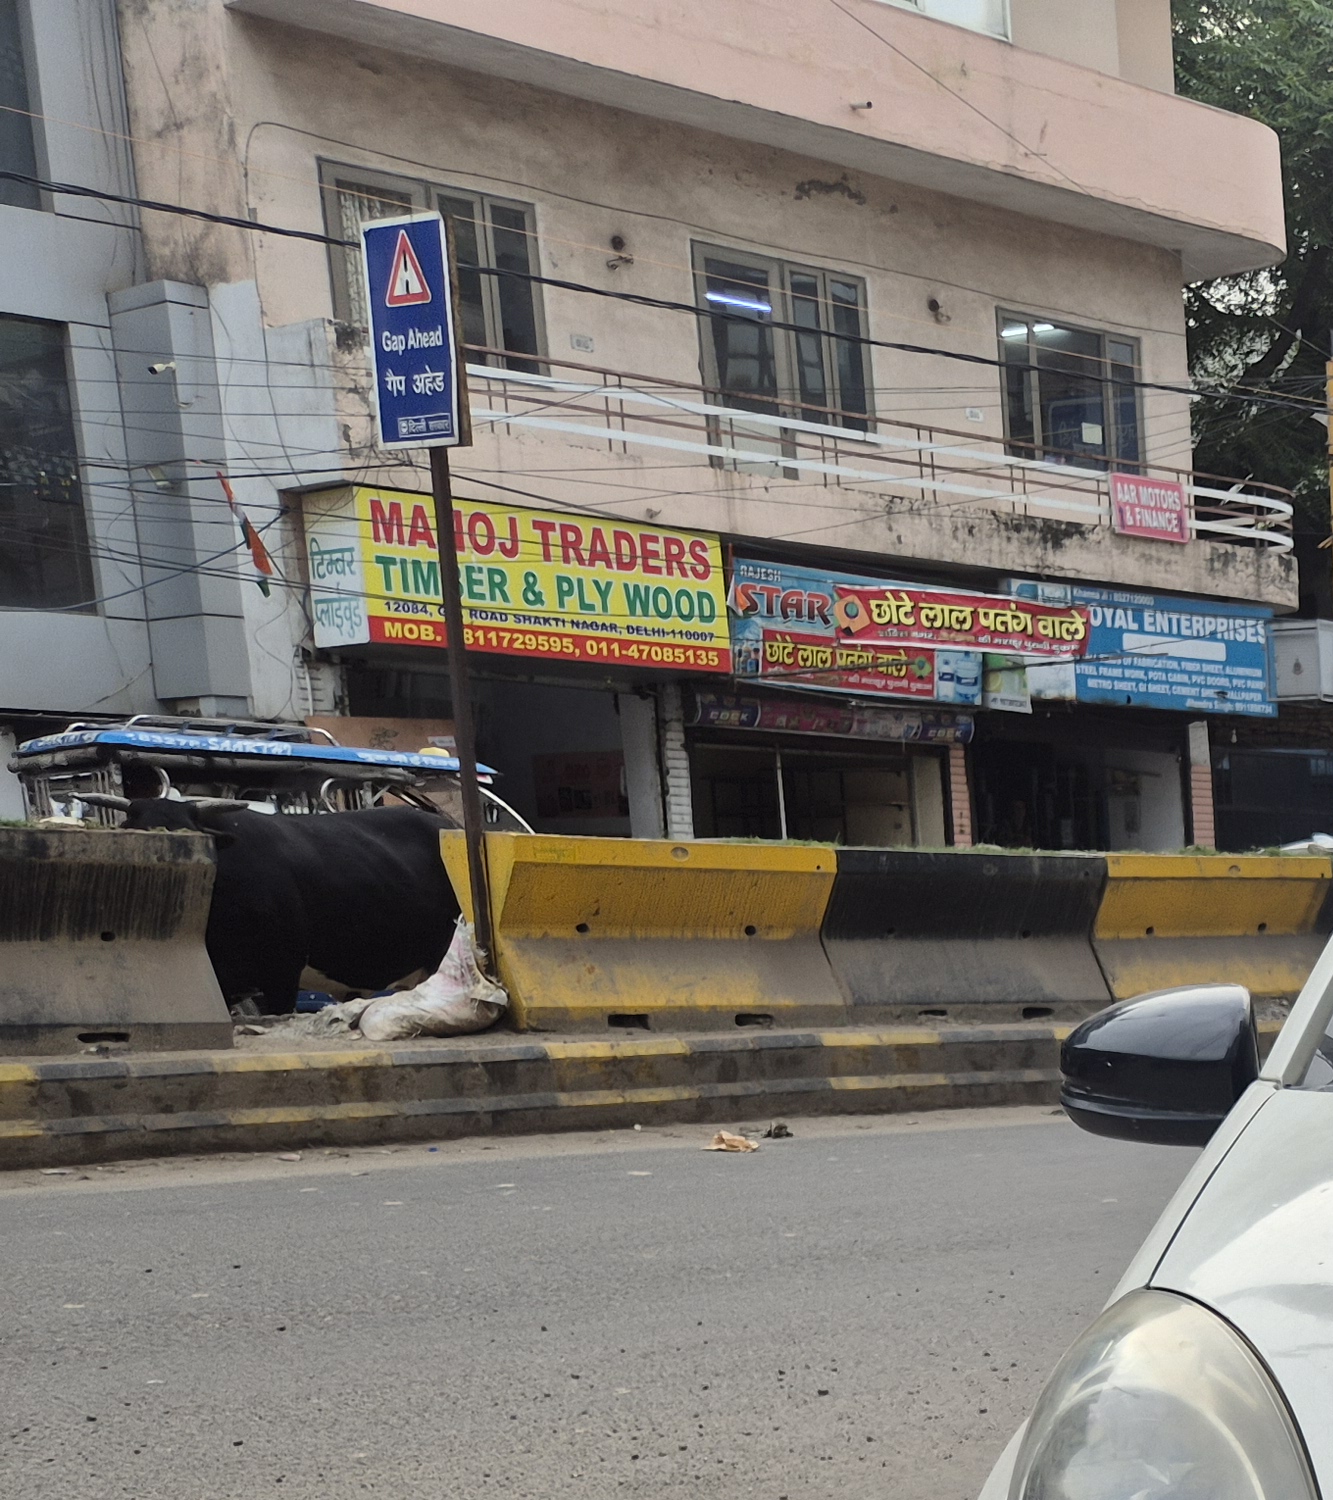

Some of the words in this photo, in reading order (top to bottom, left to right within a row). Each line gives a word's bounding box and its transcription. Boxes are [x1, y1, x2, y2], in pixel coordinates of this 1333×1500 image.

[382, 331, 406, 355] Gap
[408, 325, 443, 350] Ahead
[384, 368, 407, 397] गैप
[412, 365, 445, 396] अहेड
[1138, 485, 1181, 511] MOTORS
[1134, 507, 1180, 533] FINANCE
[532, 519, 712, 581] TRADERS
[375, 554, 510, 604] TIMER
[522, 571, 545, 607] &
[556, 574, 614, 614] PLY
[623, 582, 716, 624] WOOD
[739, 565, 782, 582] RAJESH
[469, 610, 509, 624] ROAD
[513, 614, 566, 629] SHAKTI
[571, 619, 622, 635] NAGAR,
[738, 583, 833, 629] STAR
[869, 591, 916, 626] छोटे
[919, 602, 975, 631] लाल
[977, 602, 1034, 636] पतंग
[1036, 610, 1088, 641] वाले
[1090, 604, 1139, 631] OYAL
[1144, 610, 1266, 644] ENTERPRISES
[384, 621, 443, 642] MOB.
[463, 628, 581, 657] 811729595,
[585, 640, 719, 667] 011-47085135
[764, 634, 795, 665] छोटे
[797, 643, 833, 669] लाल
[836, 643, 873, 675] पतंग
[876, 649, 908, 678] वाले
